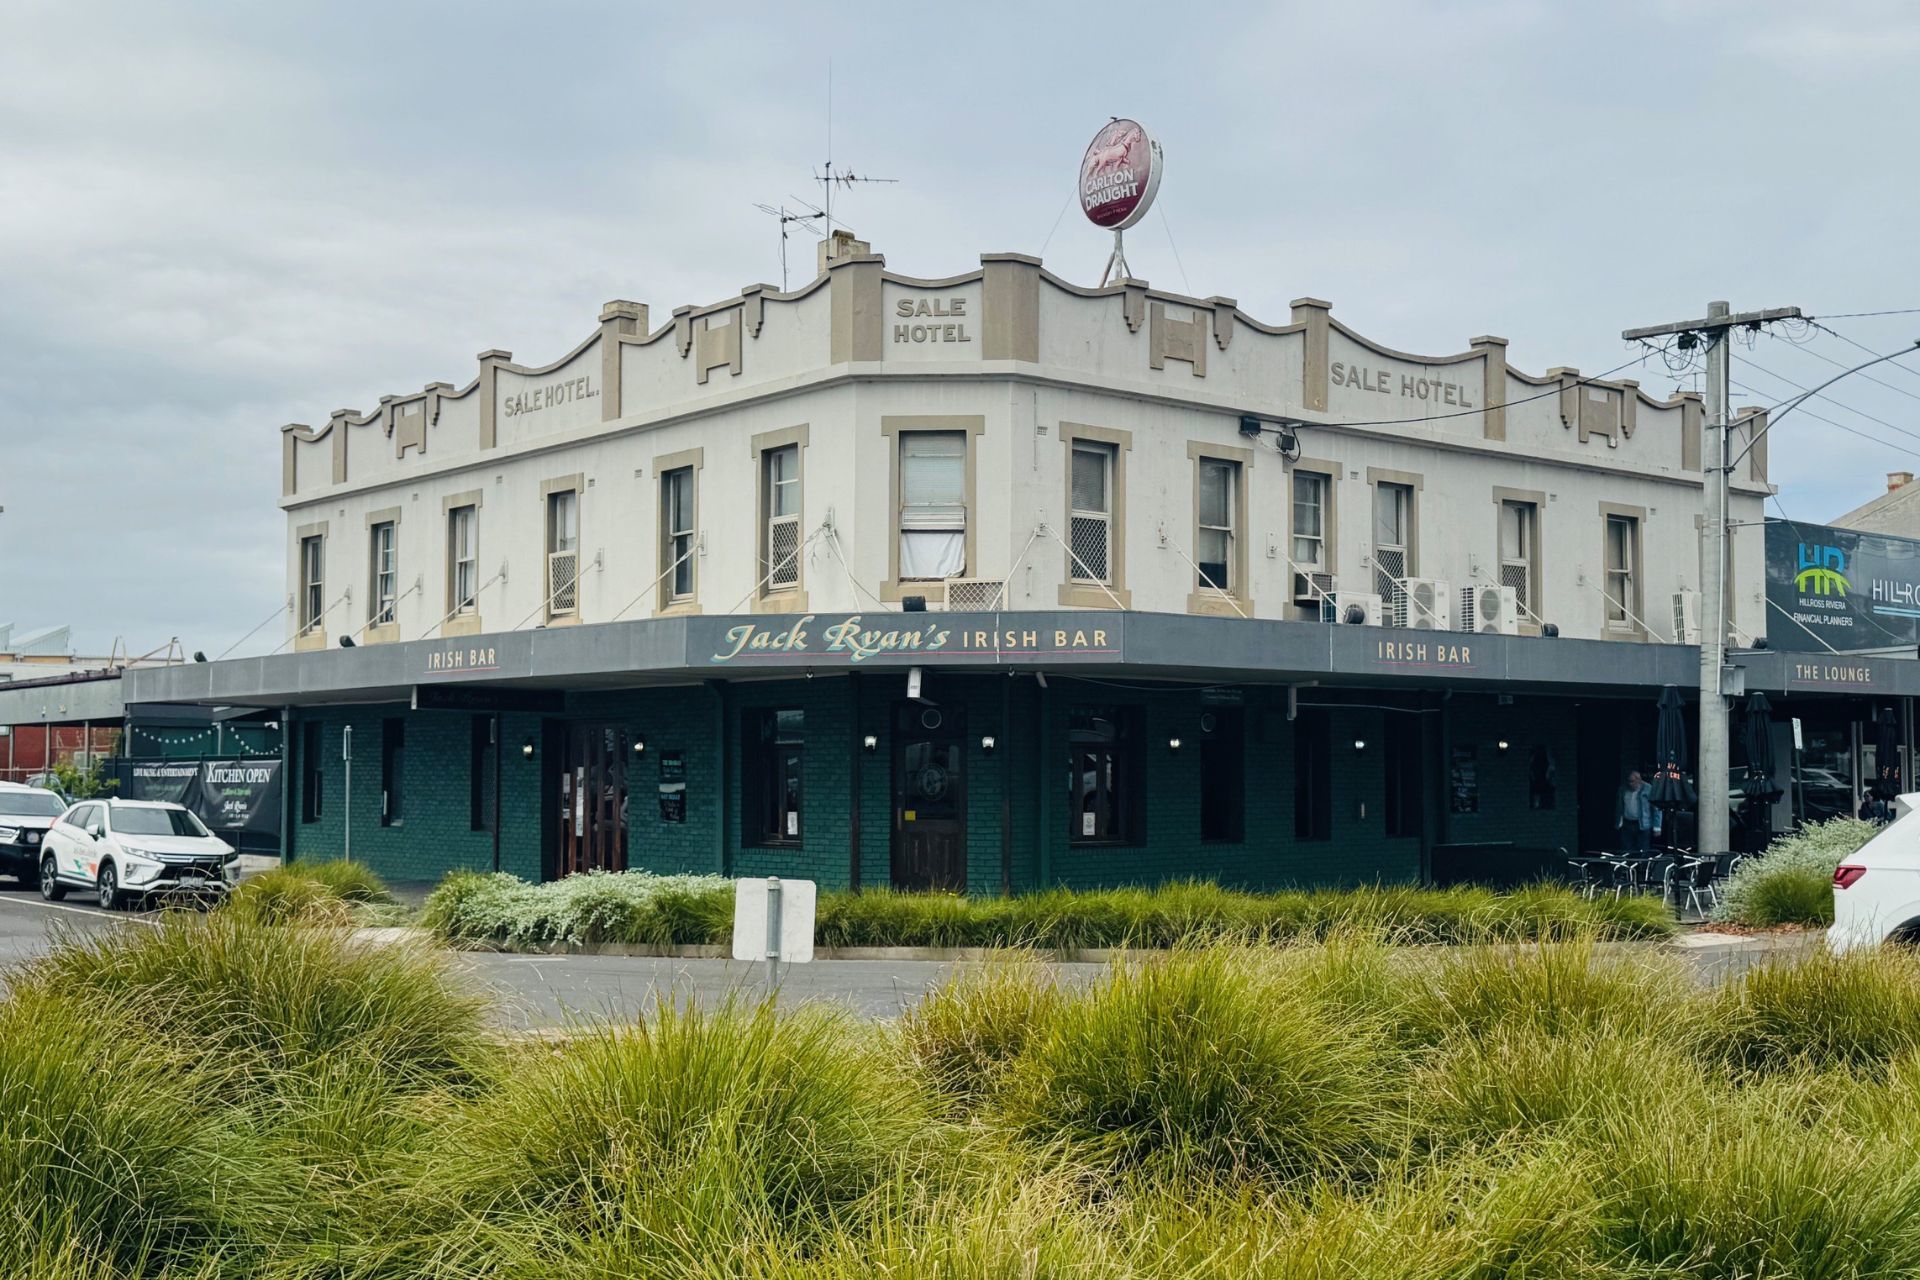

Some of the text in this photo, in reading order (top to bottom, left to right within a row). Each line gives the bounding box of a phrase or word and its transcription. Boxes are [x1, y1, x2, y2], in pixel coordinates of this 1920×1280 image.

[1086, 168, 1135, 195] CARLTON
[1085, 182, 1139, 211] DRAUGHT
[896, 298, 967, 318] SALE
[894, 323, 971, 343] HOTEL
[1330, 361, 1473, 408] SALE HOTEL
[504, 388, 543, 418] SALE
[1799, 597, 1847, 611] HILLROSS RIVIERA
[1793, 612, 1853, 627] FINANCIAL PLANNERS
[710, 615, 1108, 663] Jack Ryan's IRISH BAR
[428, 648, 496, 669] IRISH BAR
[1378, 641, 1471, 664] IRISH BAR
[1796, 664, 1871, 682] THE LOUNGE
[206, 763, 272, 783] KITCHEN OPEN
